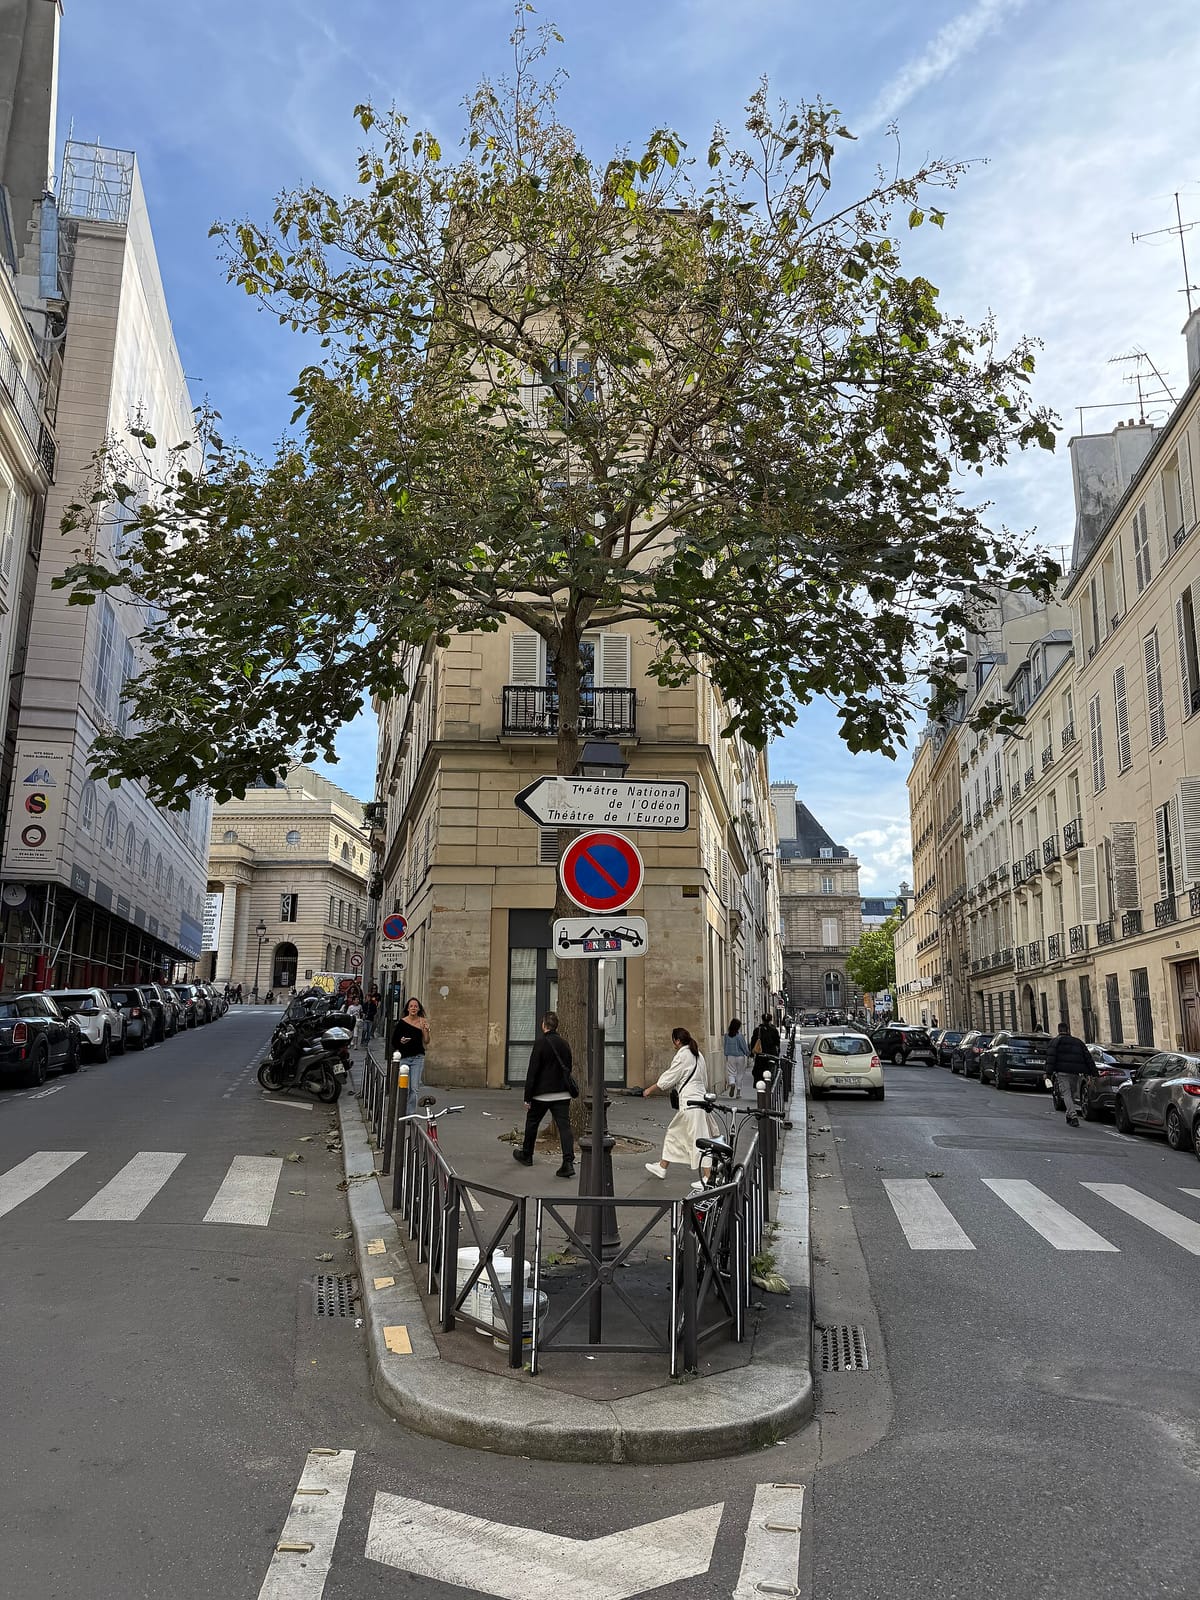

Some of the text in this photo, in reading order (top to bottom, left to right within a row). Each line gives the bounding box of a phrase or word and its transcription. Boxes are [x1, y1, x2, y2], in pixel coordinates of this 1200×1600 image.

[572, 784, 681, 798] Théâtre National
[608, 799, 680, 811] de l'Odéon
[548, 809, 680, 826] Théâtre de l'Europe
